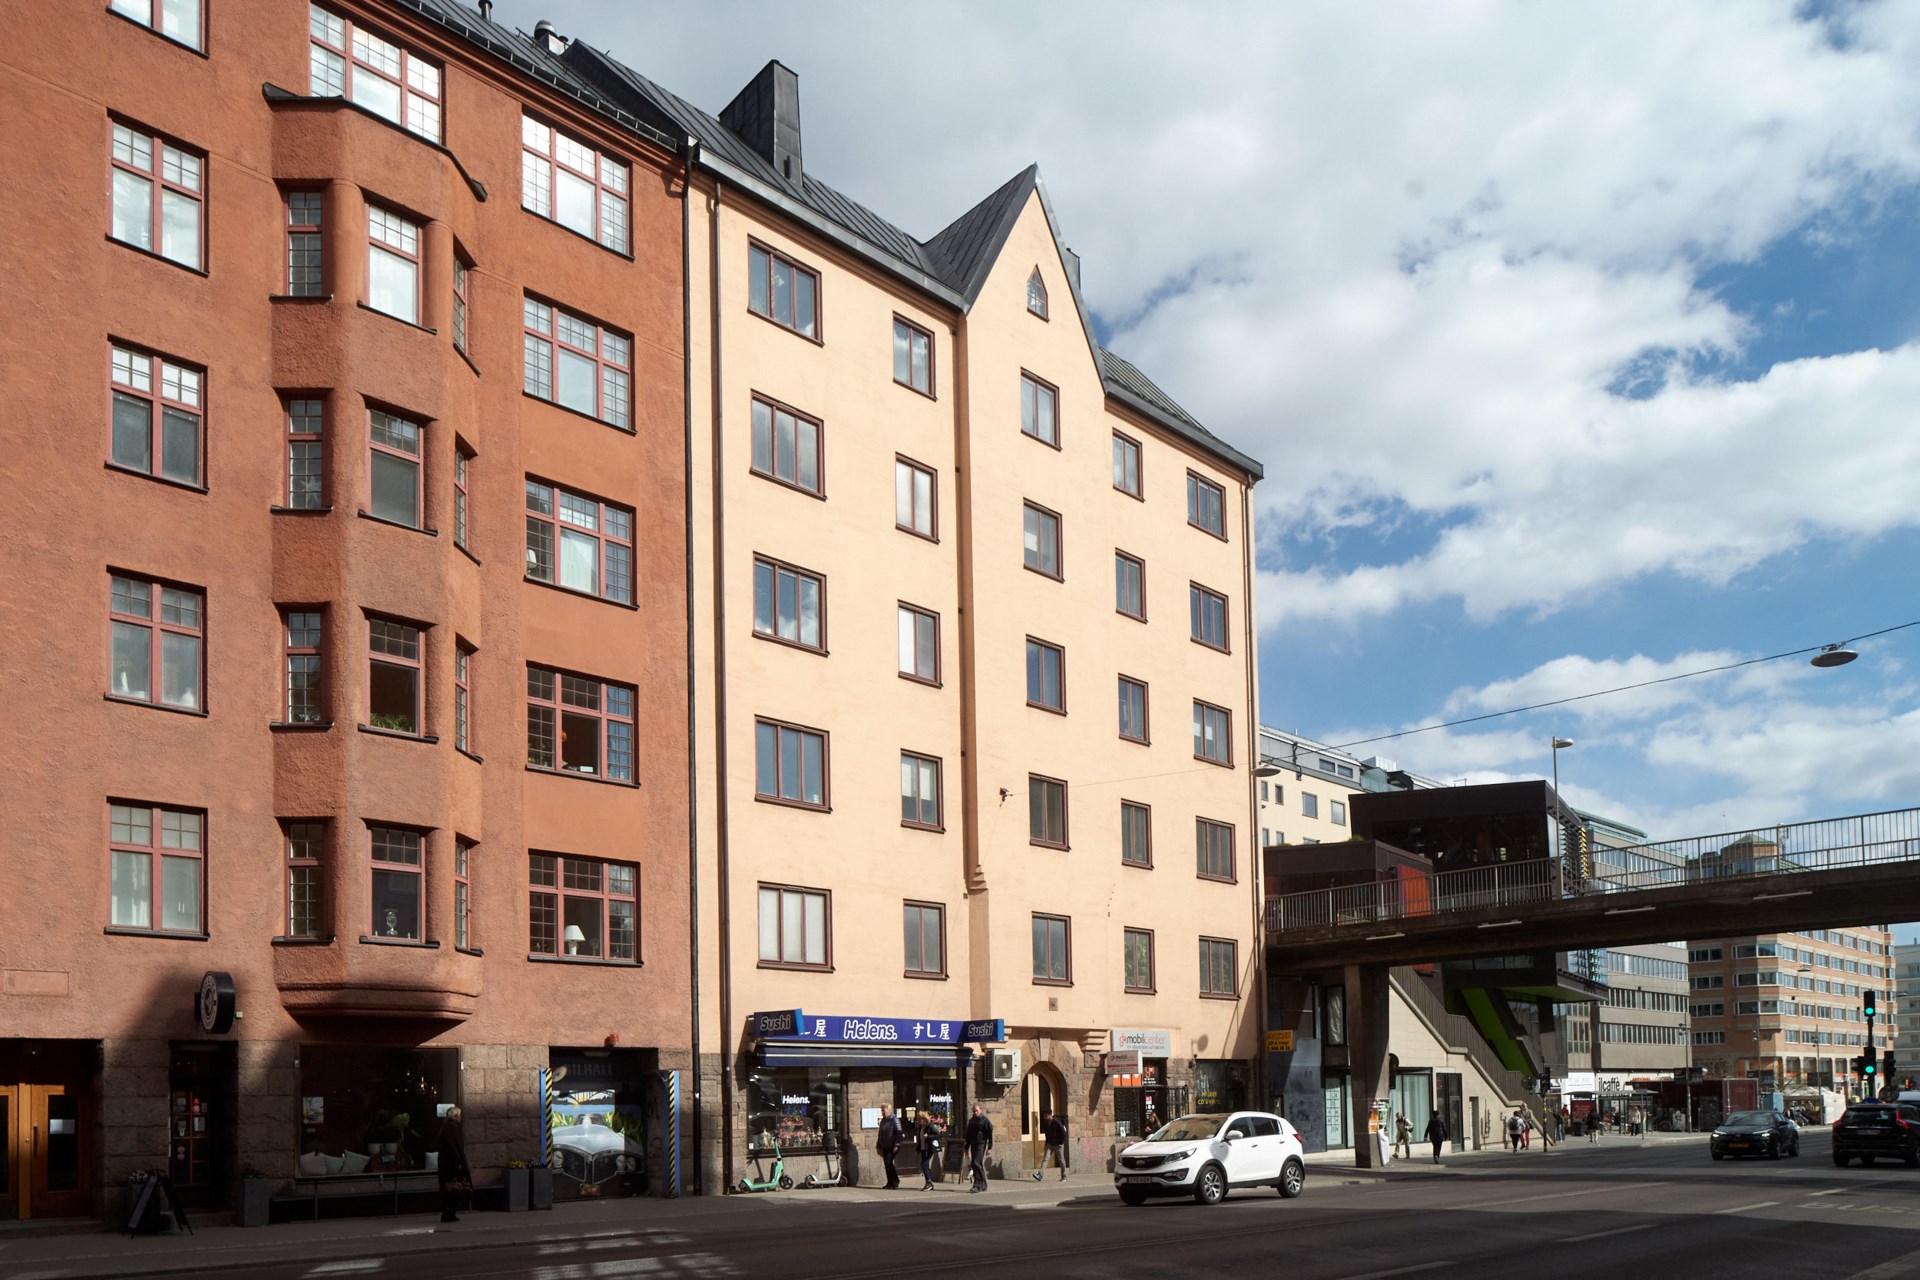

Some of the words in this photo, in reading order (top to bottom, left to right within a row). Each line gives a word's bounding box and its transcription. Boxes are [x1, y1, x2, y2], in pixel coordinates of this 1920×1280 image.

[760, 1014, 791, 1031] Sushi
[843, 1019, 898, 1040] Helens.
[912, 1022, 950, 1040] すし屋
[967, 1022, 994, 1038] Sushi
